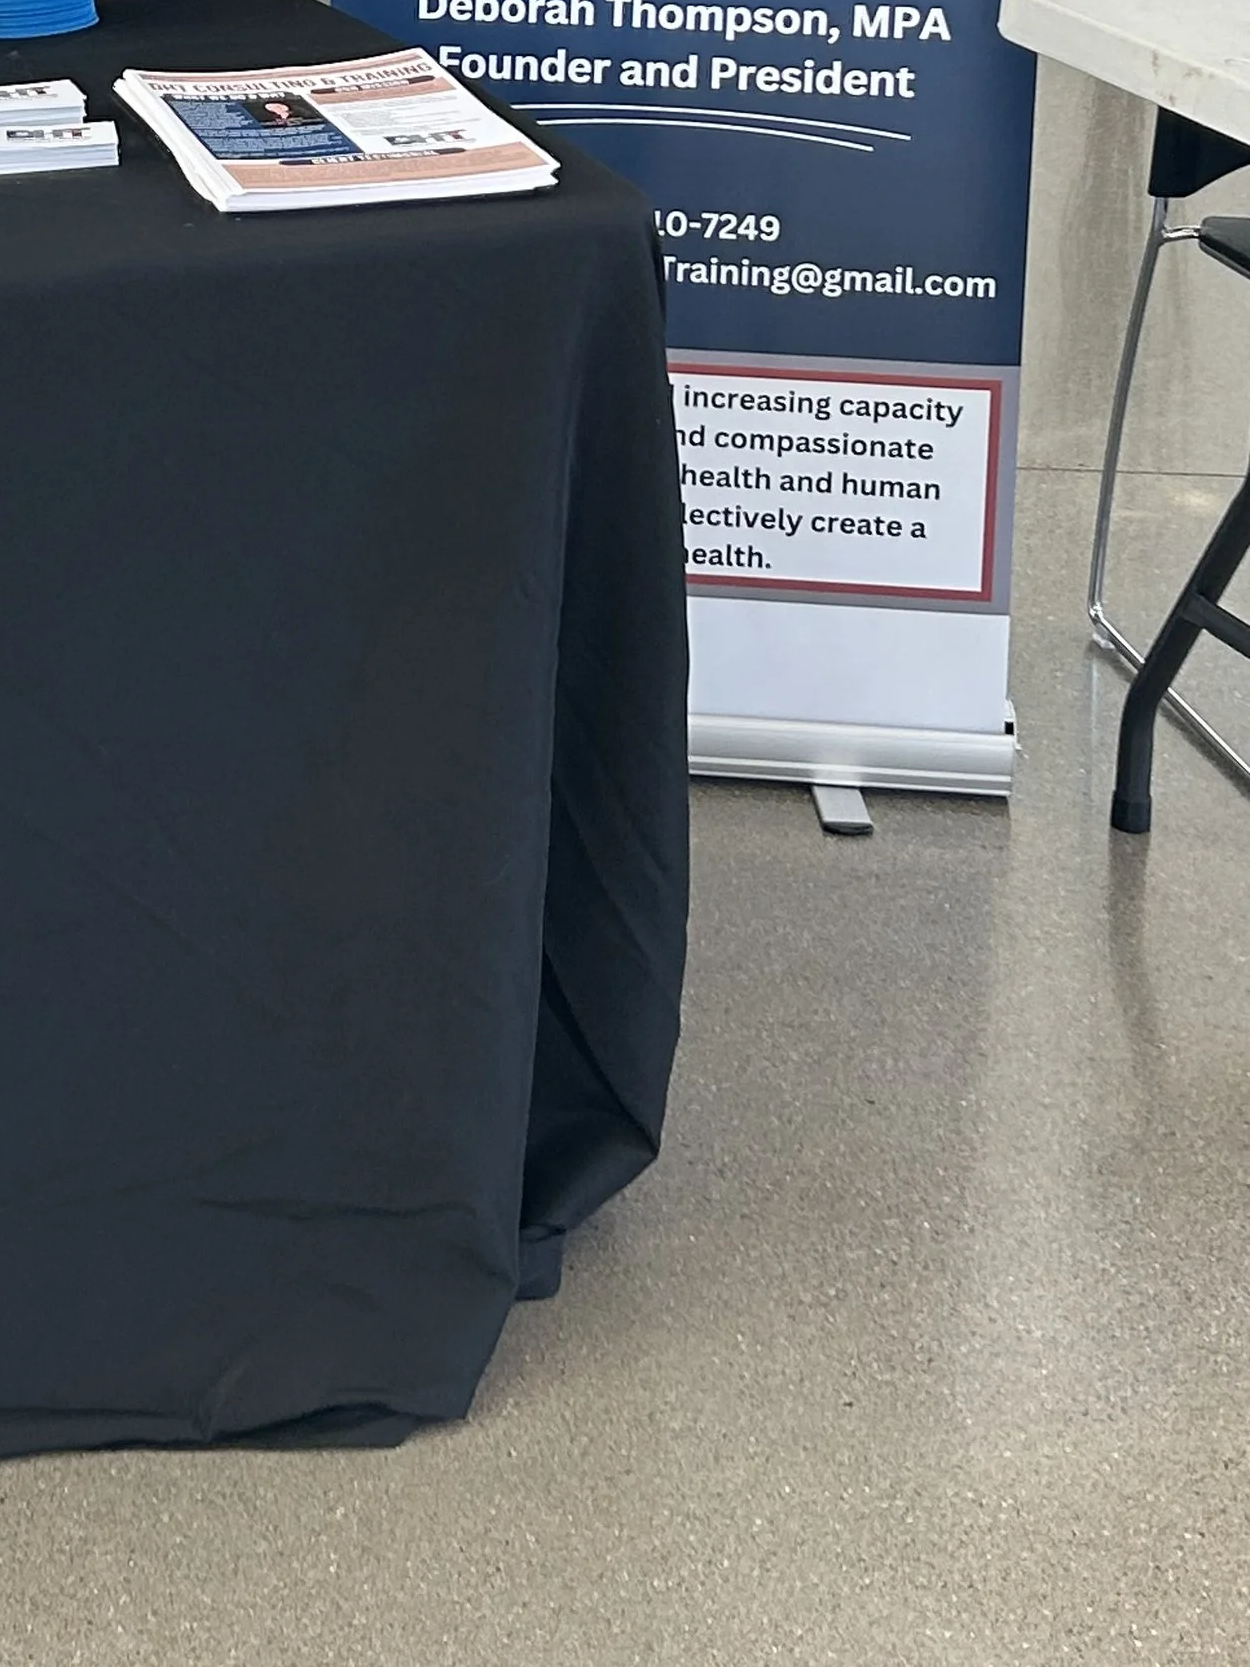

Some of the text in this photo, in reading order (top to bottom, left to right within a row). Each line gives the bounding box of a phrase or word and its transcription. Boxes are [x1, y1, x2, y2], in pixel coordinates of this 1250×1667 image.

[852, 4, 952, 41] MPA
[438, 44, 916, 99] Founder and President
[683, 384, 832, 421] increasing
[839, 396, 964, 428] capacity
[714, 430, 934, 461] compassionate
[681, 464, 941, 501] health and human
[811, 514, 902, 538] create
[910, 521, 927, 540] a
